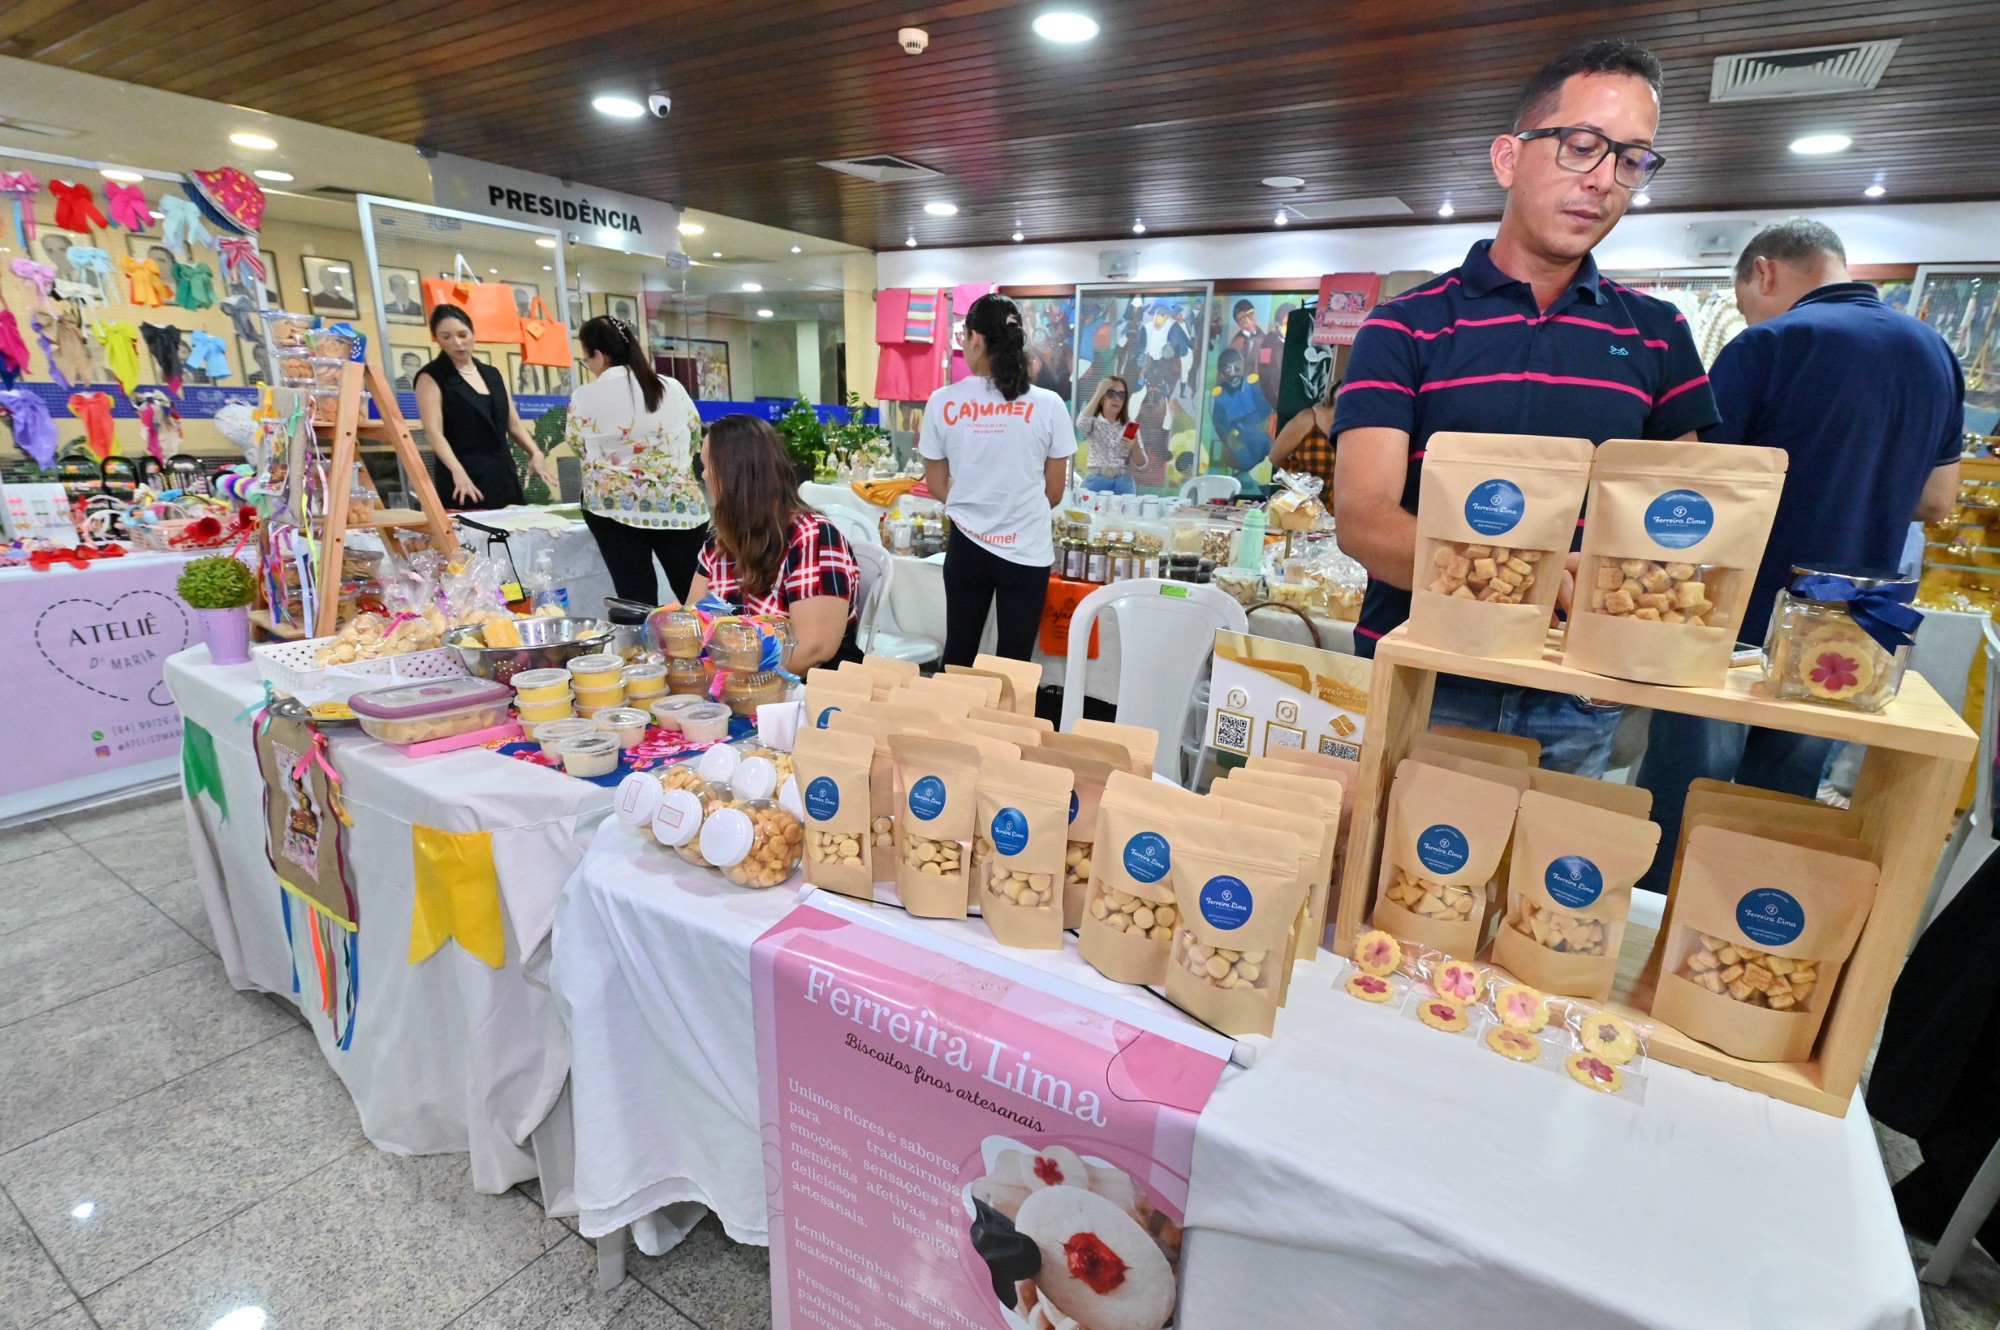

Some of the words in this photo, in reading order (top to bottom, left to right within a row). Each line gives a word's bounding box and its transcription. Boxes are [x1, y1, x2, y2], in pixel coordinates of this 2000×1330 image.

[488, 185, 642, 234] PRESIDÊNCIA
[1472, 503, 1499, 512] Ferreira
[1500, 506, 1517, 515] Lima
[1686, 517, 1706, 525] Lima
[69, 612, 160, 647] ATELIÊ
[111, 650, 156, 670] MARIA
[1206, 897, 1230, 907] Ferreira
[1231, 902, 1247, 911] Lima
[1745, 909, 1775, 922] Ferreira
[1776, 917, 1797, 927] Lima
[804, 964, 972, 1072] Ferreira
[982, 1040, 1107, 1128] Lima
[845, 1032, 913, 1074] Biscoitos
[913, 1066, 954, 1094] finos
[956, 1087, 1045, 1132] artesanais
[788, 1077, 840, 1115] Unimos
[843, 1106, 885, 1137] flores
[888, 1132, 896, 1143] e
[900, 1137, 960, 1175] sabores
[789, 1101, 821, 1125] para
[866, 1139, 960, 1196] traduzirmos
[791, 1140, 858, 1184] memórias
[866, 1181, 927, 1220] afetivas
[935, 1219, 959, 1238] em
[791, 1160, 858, 1204] deliciosos
[891, 1211, 959, 1259] biscoitos
[792, 1180, 868, 1228] artesanais.
[863, 1159, 939, 1206] sensações
[950, 1205, 960, 1217] e
[793, 1217, 903, 1288] Lembrancinhas:
[796, 1267, 861, 1314] Presentes
[797, 1288, 863, 1330] padrinhos
